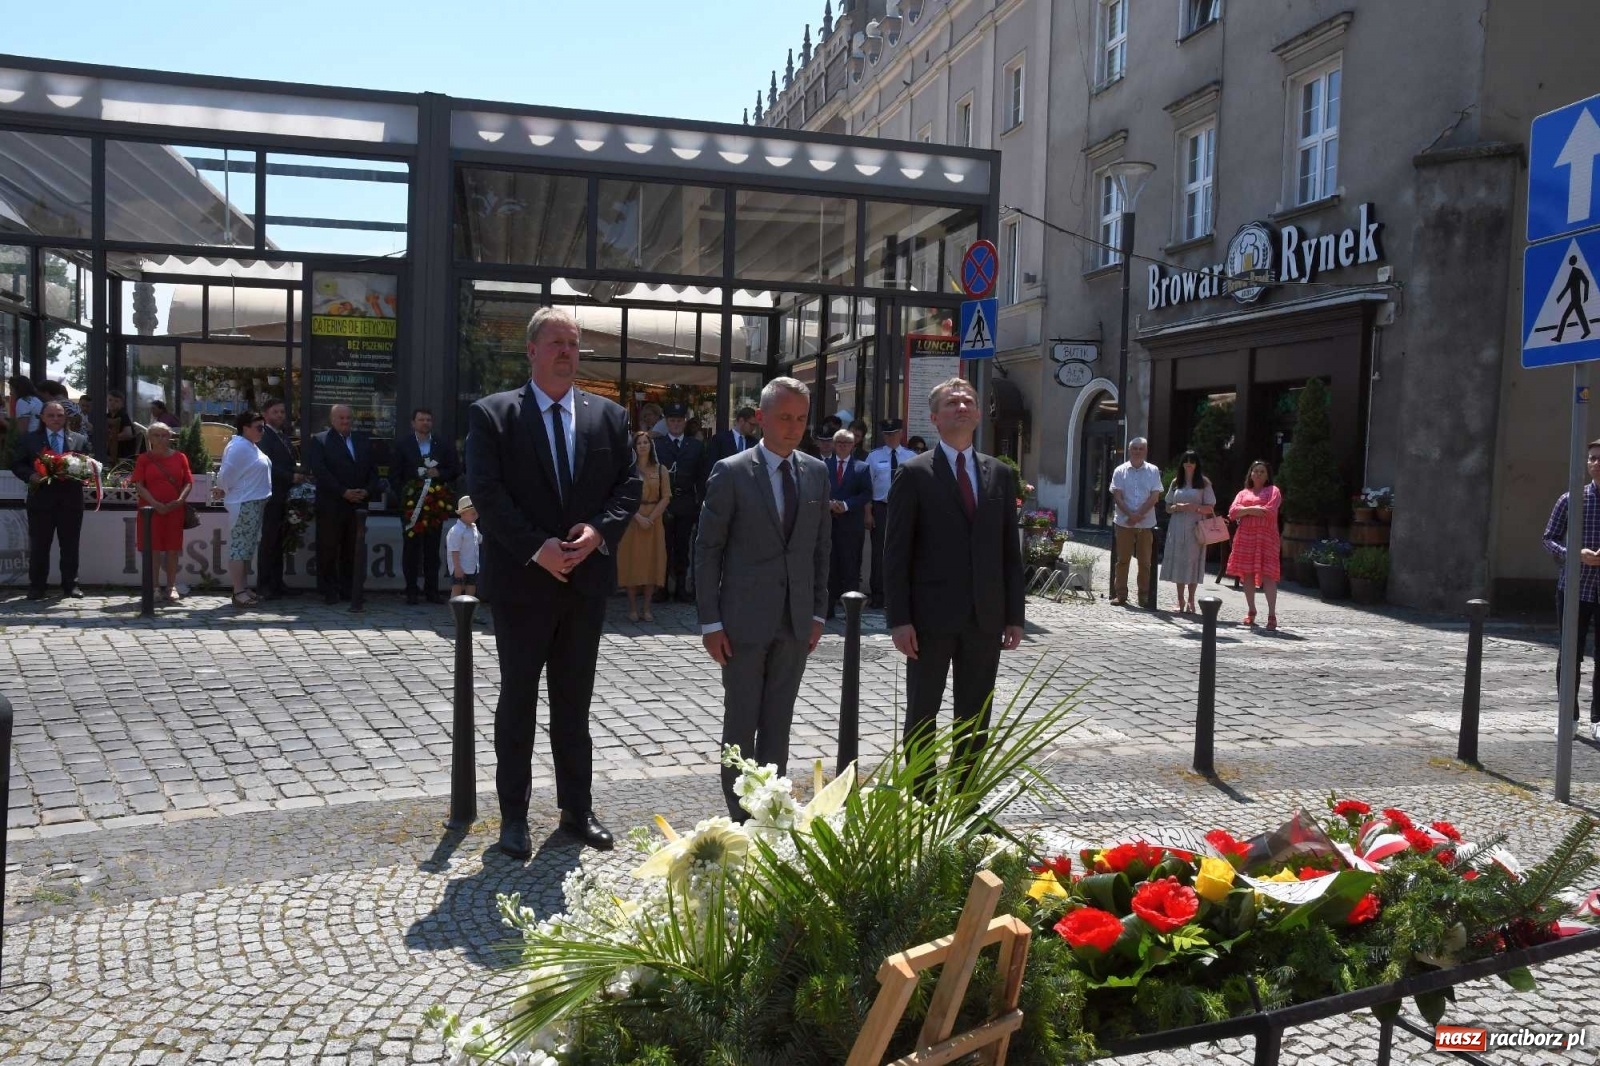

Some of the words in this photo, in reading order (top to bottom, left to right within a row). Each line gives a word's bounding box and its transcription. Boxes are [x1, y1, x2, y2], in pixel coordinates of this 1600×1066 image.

[1148, 263, 1225, 311] Browar
[1280, 203, 1379, 284] Rynek
[314, 319, 347, 334] CATERING
[349, 320, 394, 336] DIETETYCZNY
[347, 340, 360, 350] BEZ
[917, 340, 955, 351] LUNCH
[1063, 346, 1089, 358] BUTIK
